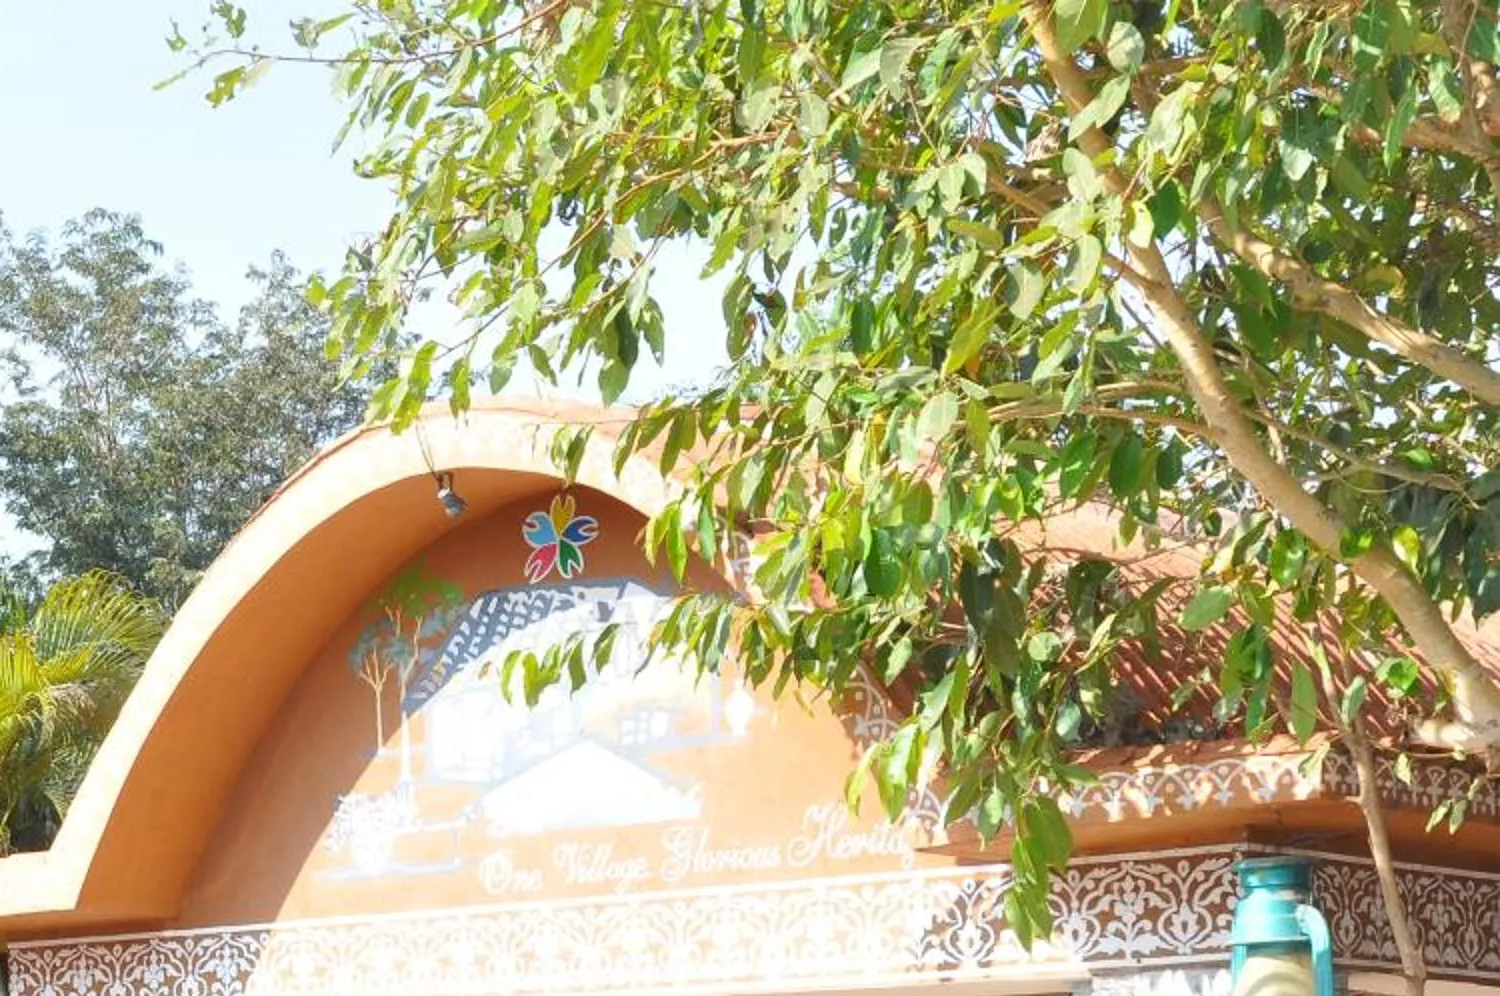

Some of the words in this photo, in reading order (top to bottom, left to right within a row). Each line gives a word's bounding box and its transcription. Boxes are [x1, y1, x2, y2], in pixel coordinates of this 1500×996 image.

[478, 849, 544, 895] One
[553, 841, 650, 896] Village
[660, 825, 782, 881] Glorious
[787, 801, 915, 870] Heritag
